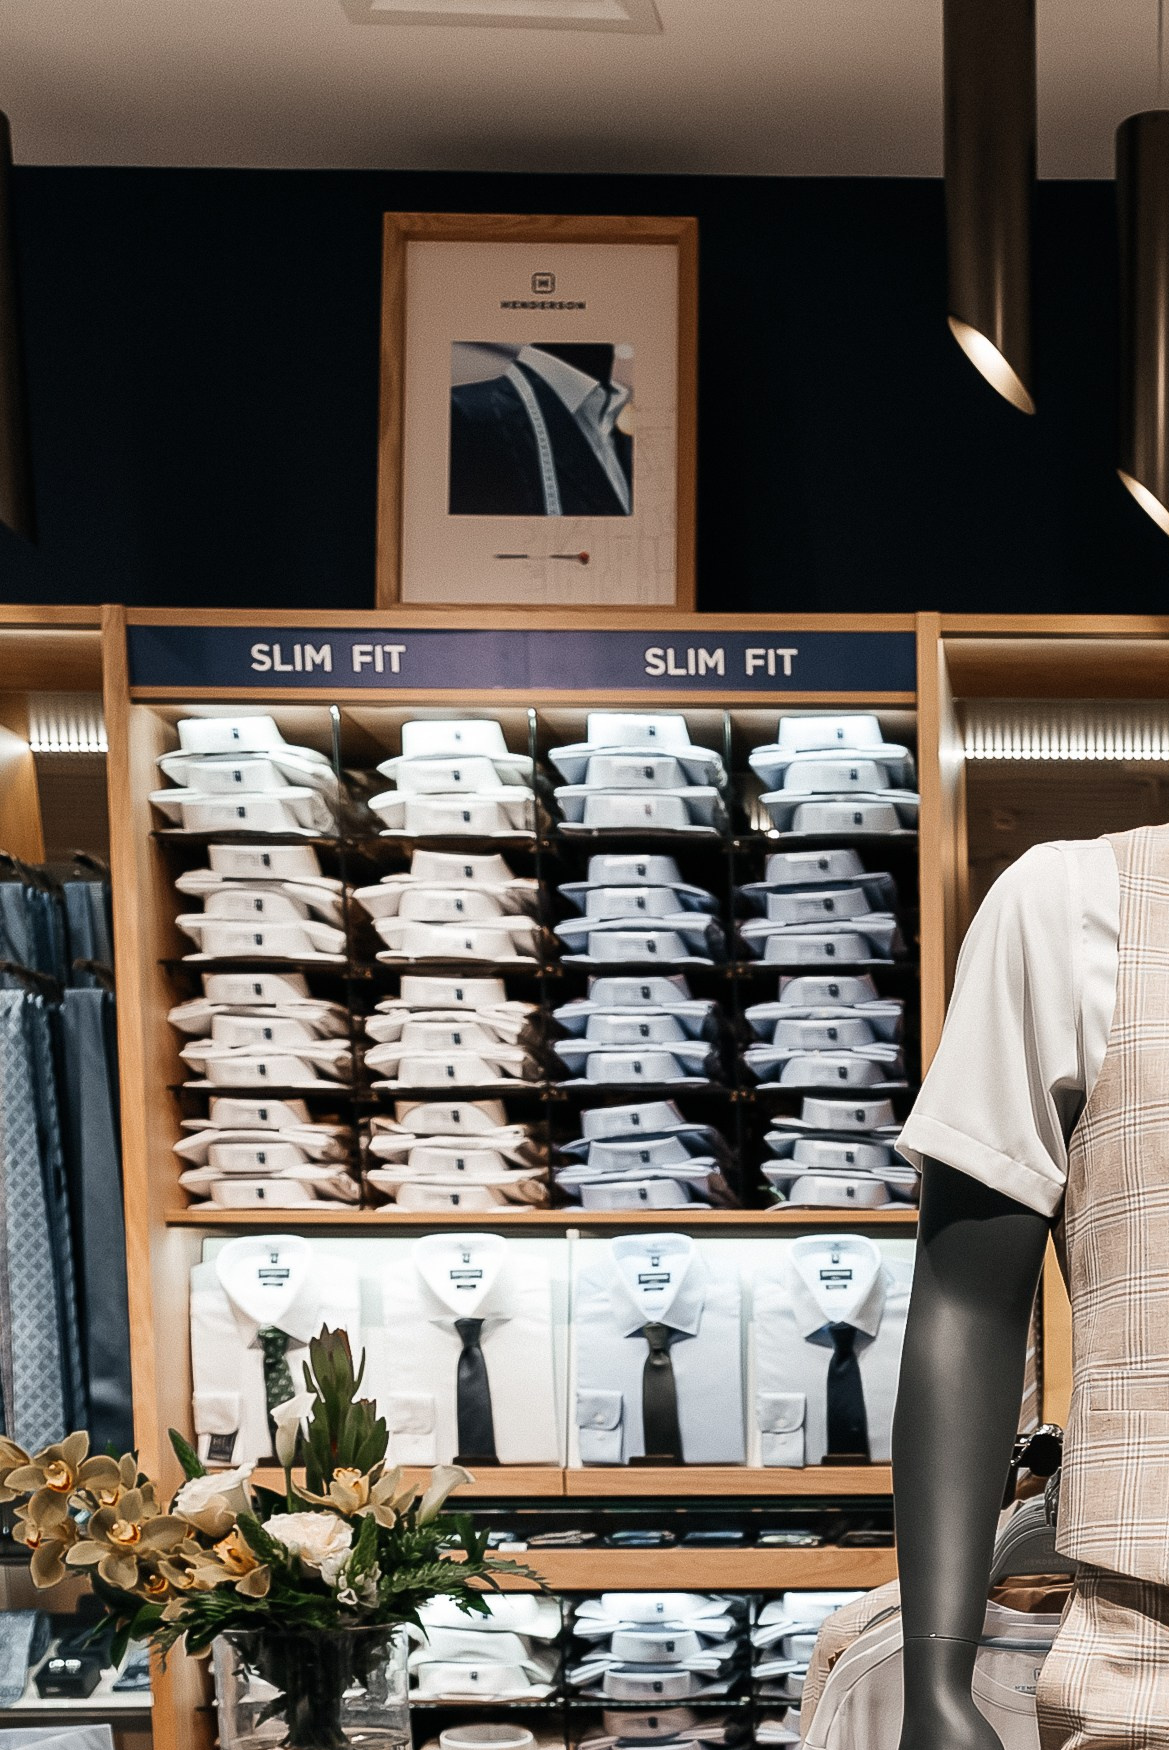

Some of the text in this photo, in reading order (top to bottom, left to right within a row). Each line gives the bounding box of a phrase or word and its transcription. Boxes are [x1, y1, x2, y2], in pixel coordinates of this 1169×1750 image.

[500, 301, 586, 310] HENDERSON
[250, 643, 407, 673] SLIM FIT
[644, 647, 799, 677] SLIM FIT
